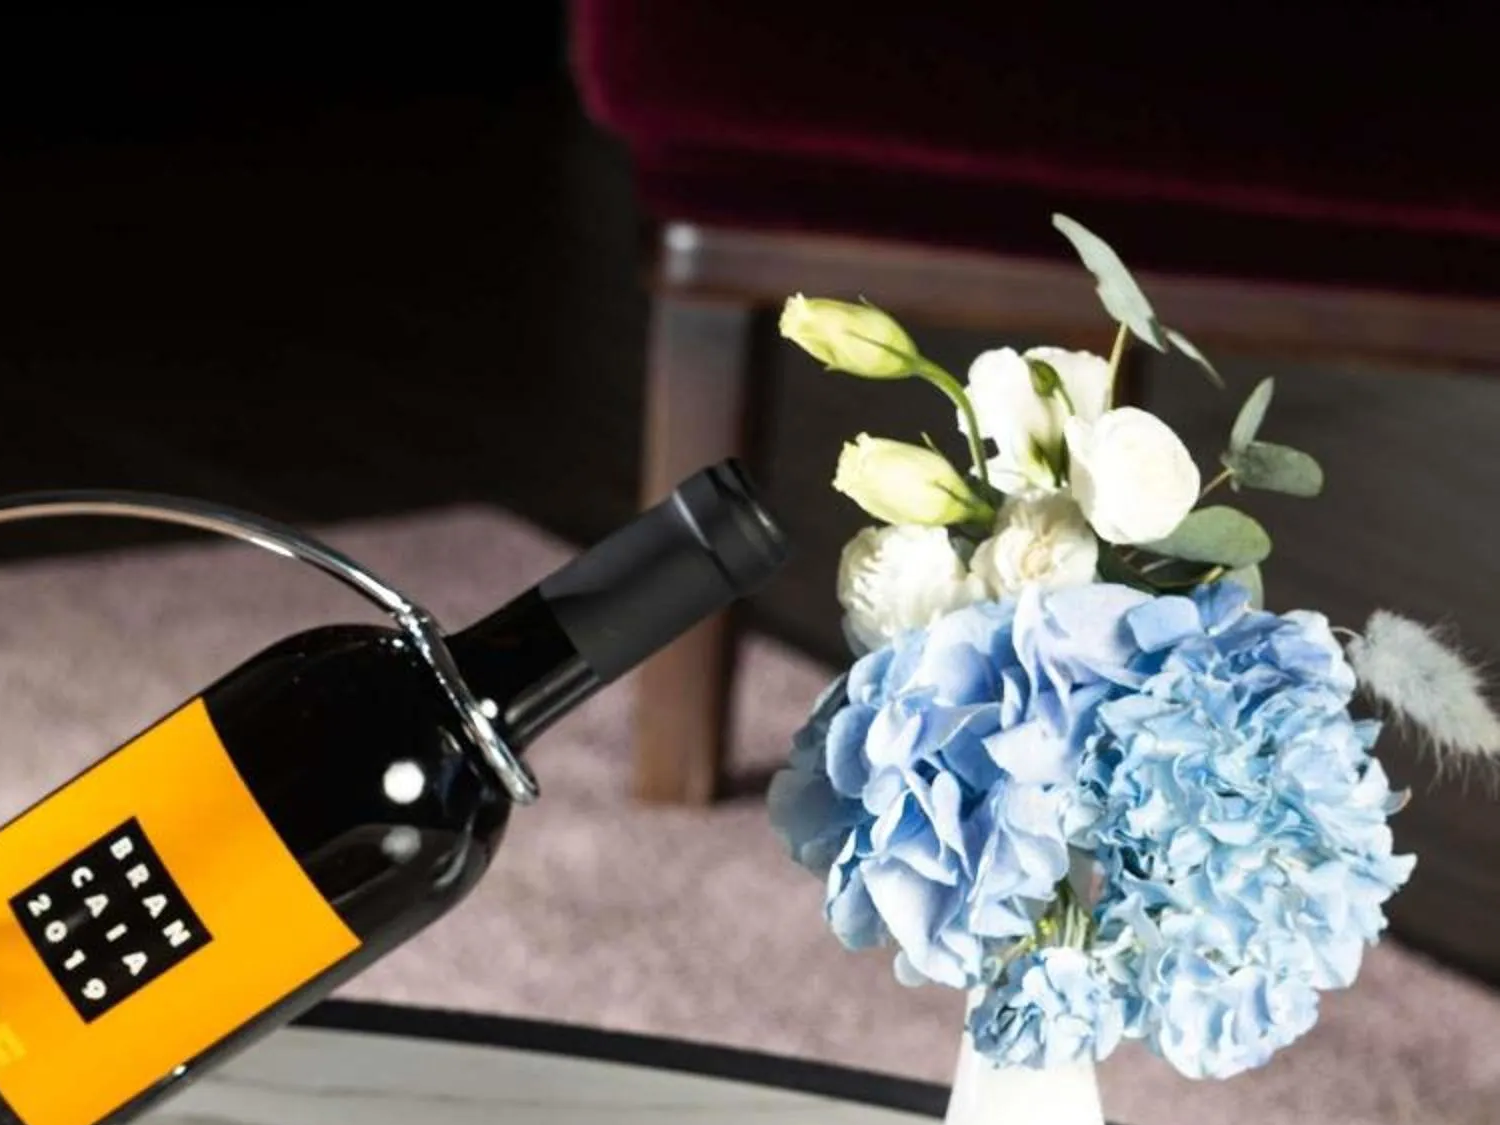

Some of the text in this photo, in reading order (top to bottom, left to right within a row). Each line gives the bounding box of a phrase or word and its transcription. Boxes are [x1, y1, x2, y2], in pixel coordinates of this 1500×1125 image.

[28, 893, 107, 1000] 2019
[71, 866, 149, 976] CAIA
[110, 836, 191, 948] BRAN
